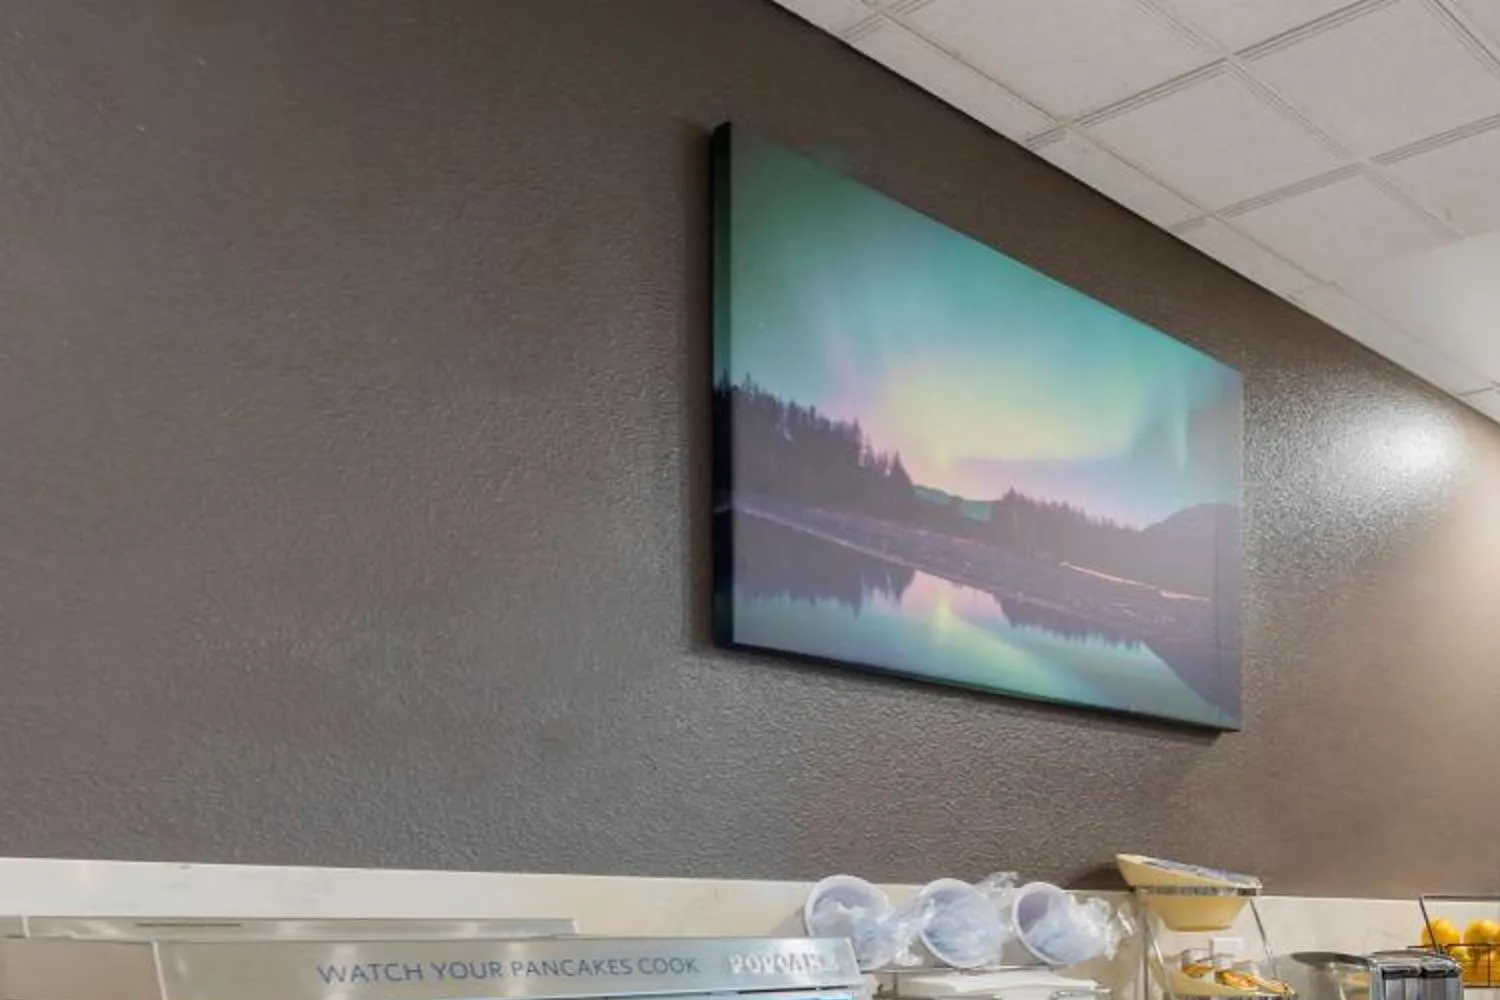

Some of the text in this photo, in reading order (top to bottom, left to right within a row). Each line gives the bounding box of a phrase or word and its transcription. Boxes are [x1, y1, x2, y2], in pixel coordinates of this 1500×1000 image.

[316, 956, 700, 984] WATCH YOUR PANCAKES COOK
[728, 951, 843, 974] POPCAK
